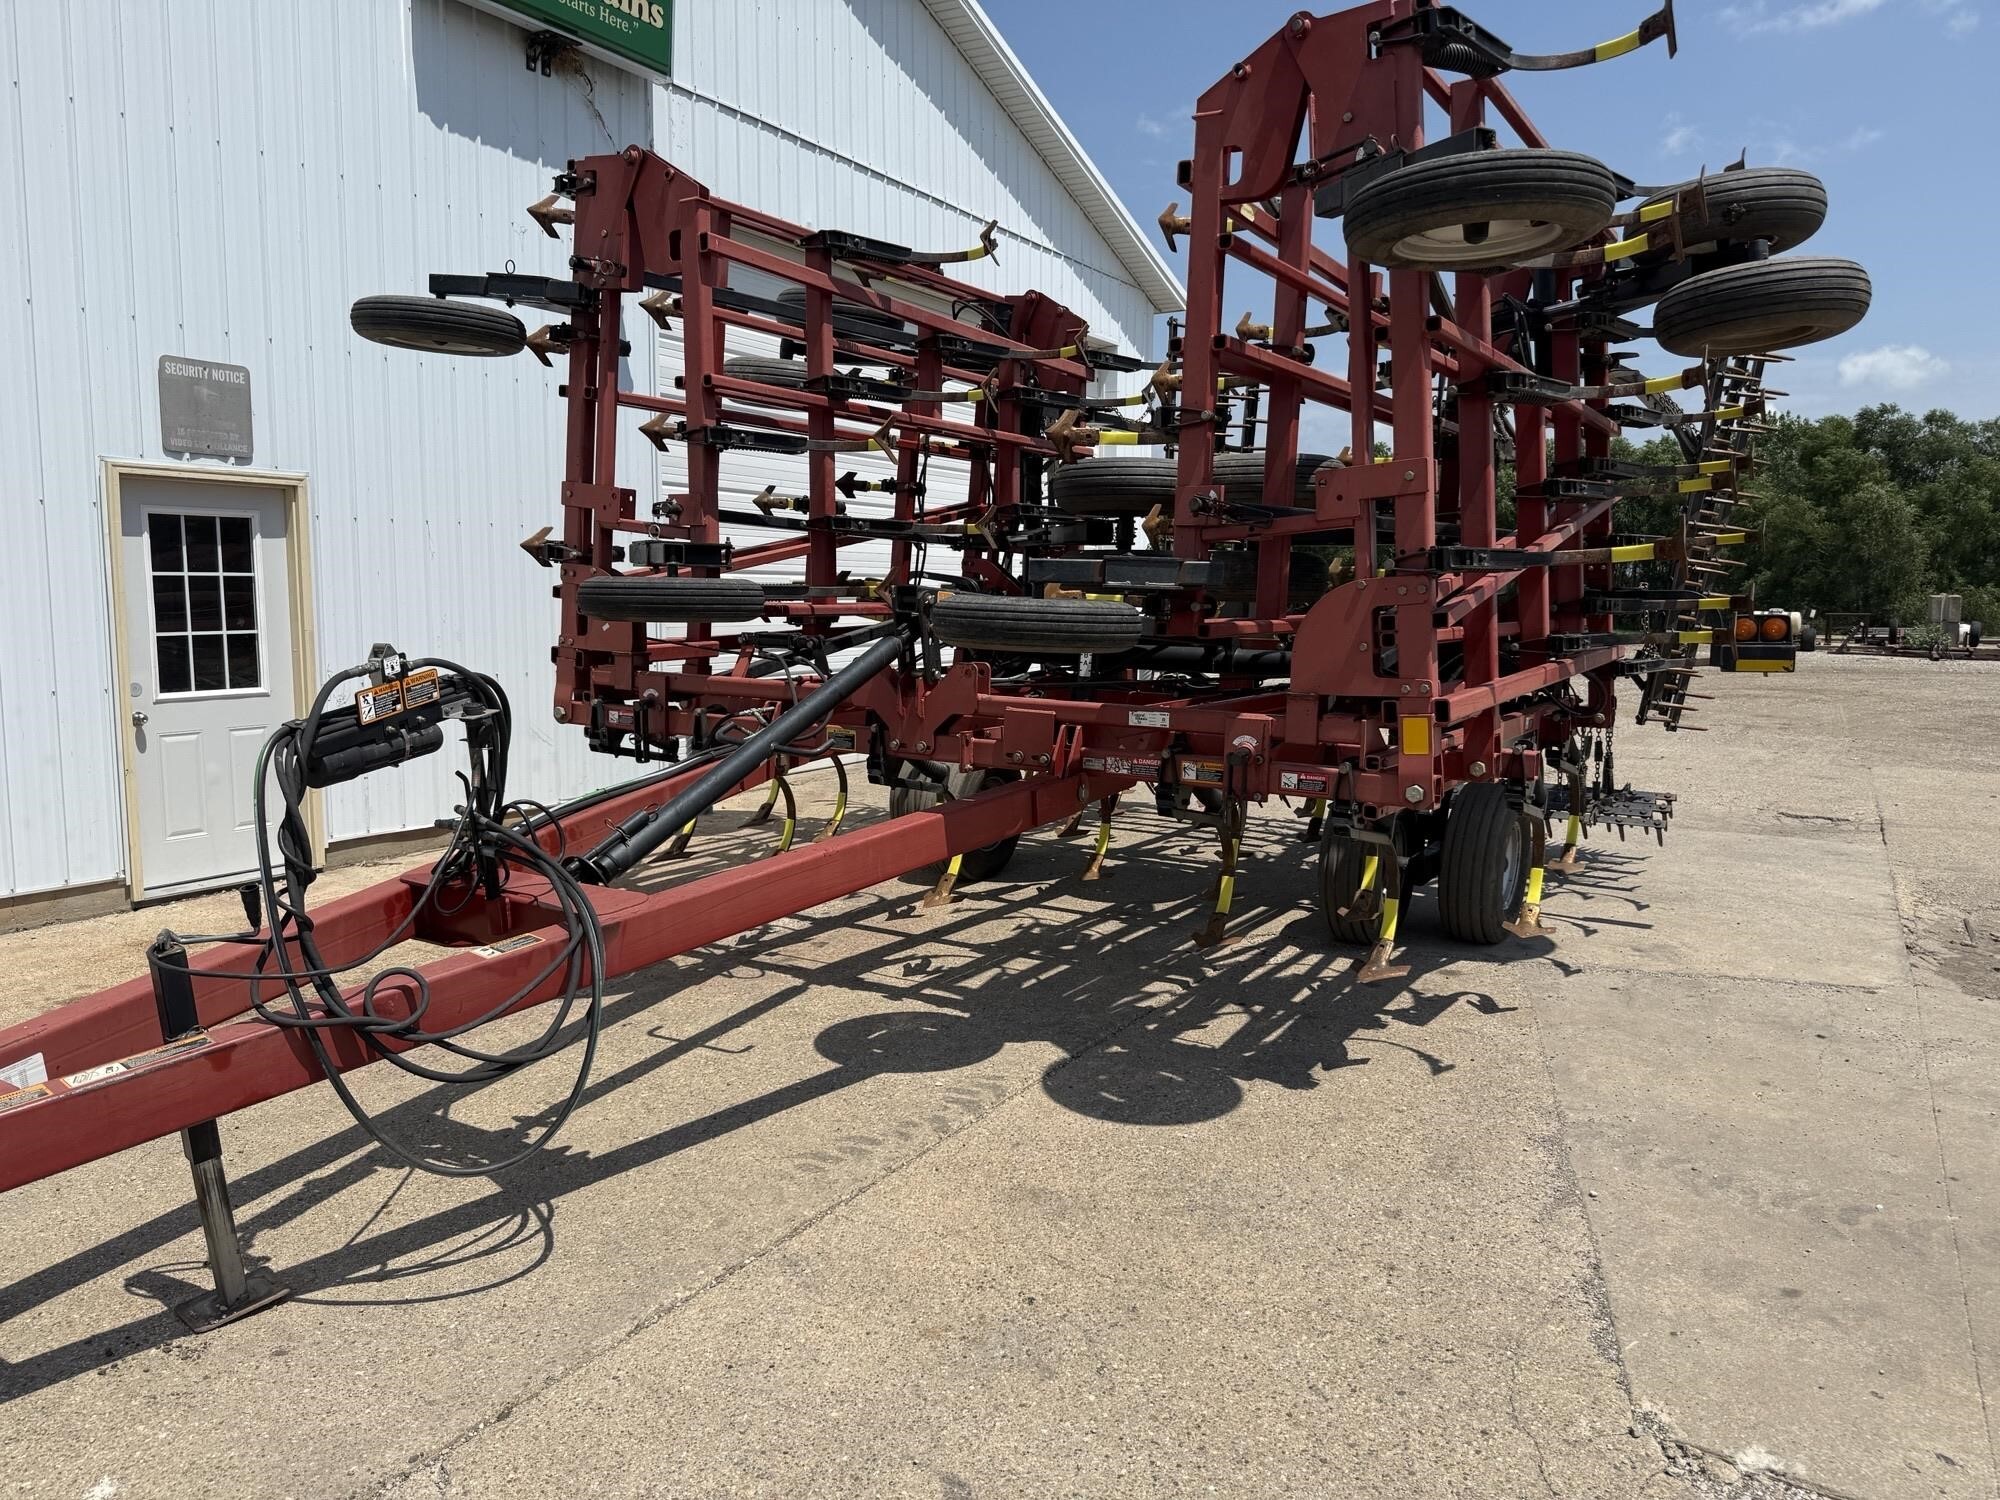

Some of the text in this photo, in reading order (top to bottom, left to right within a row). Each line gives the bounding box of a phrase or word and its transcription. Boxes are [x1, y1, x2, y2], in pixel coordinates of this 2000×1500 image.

[559, 0, 595, 17] tarts
[164, 361, 245, 385] SECURITY NOTICE
[410, 671, 436, 684] WARNING
